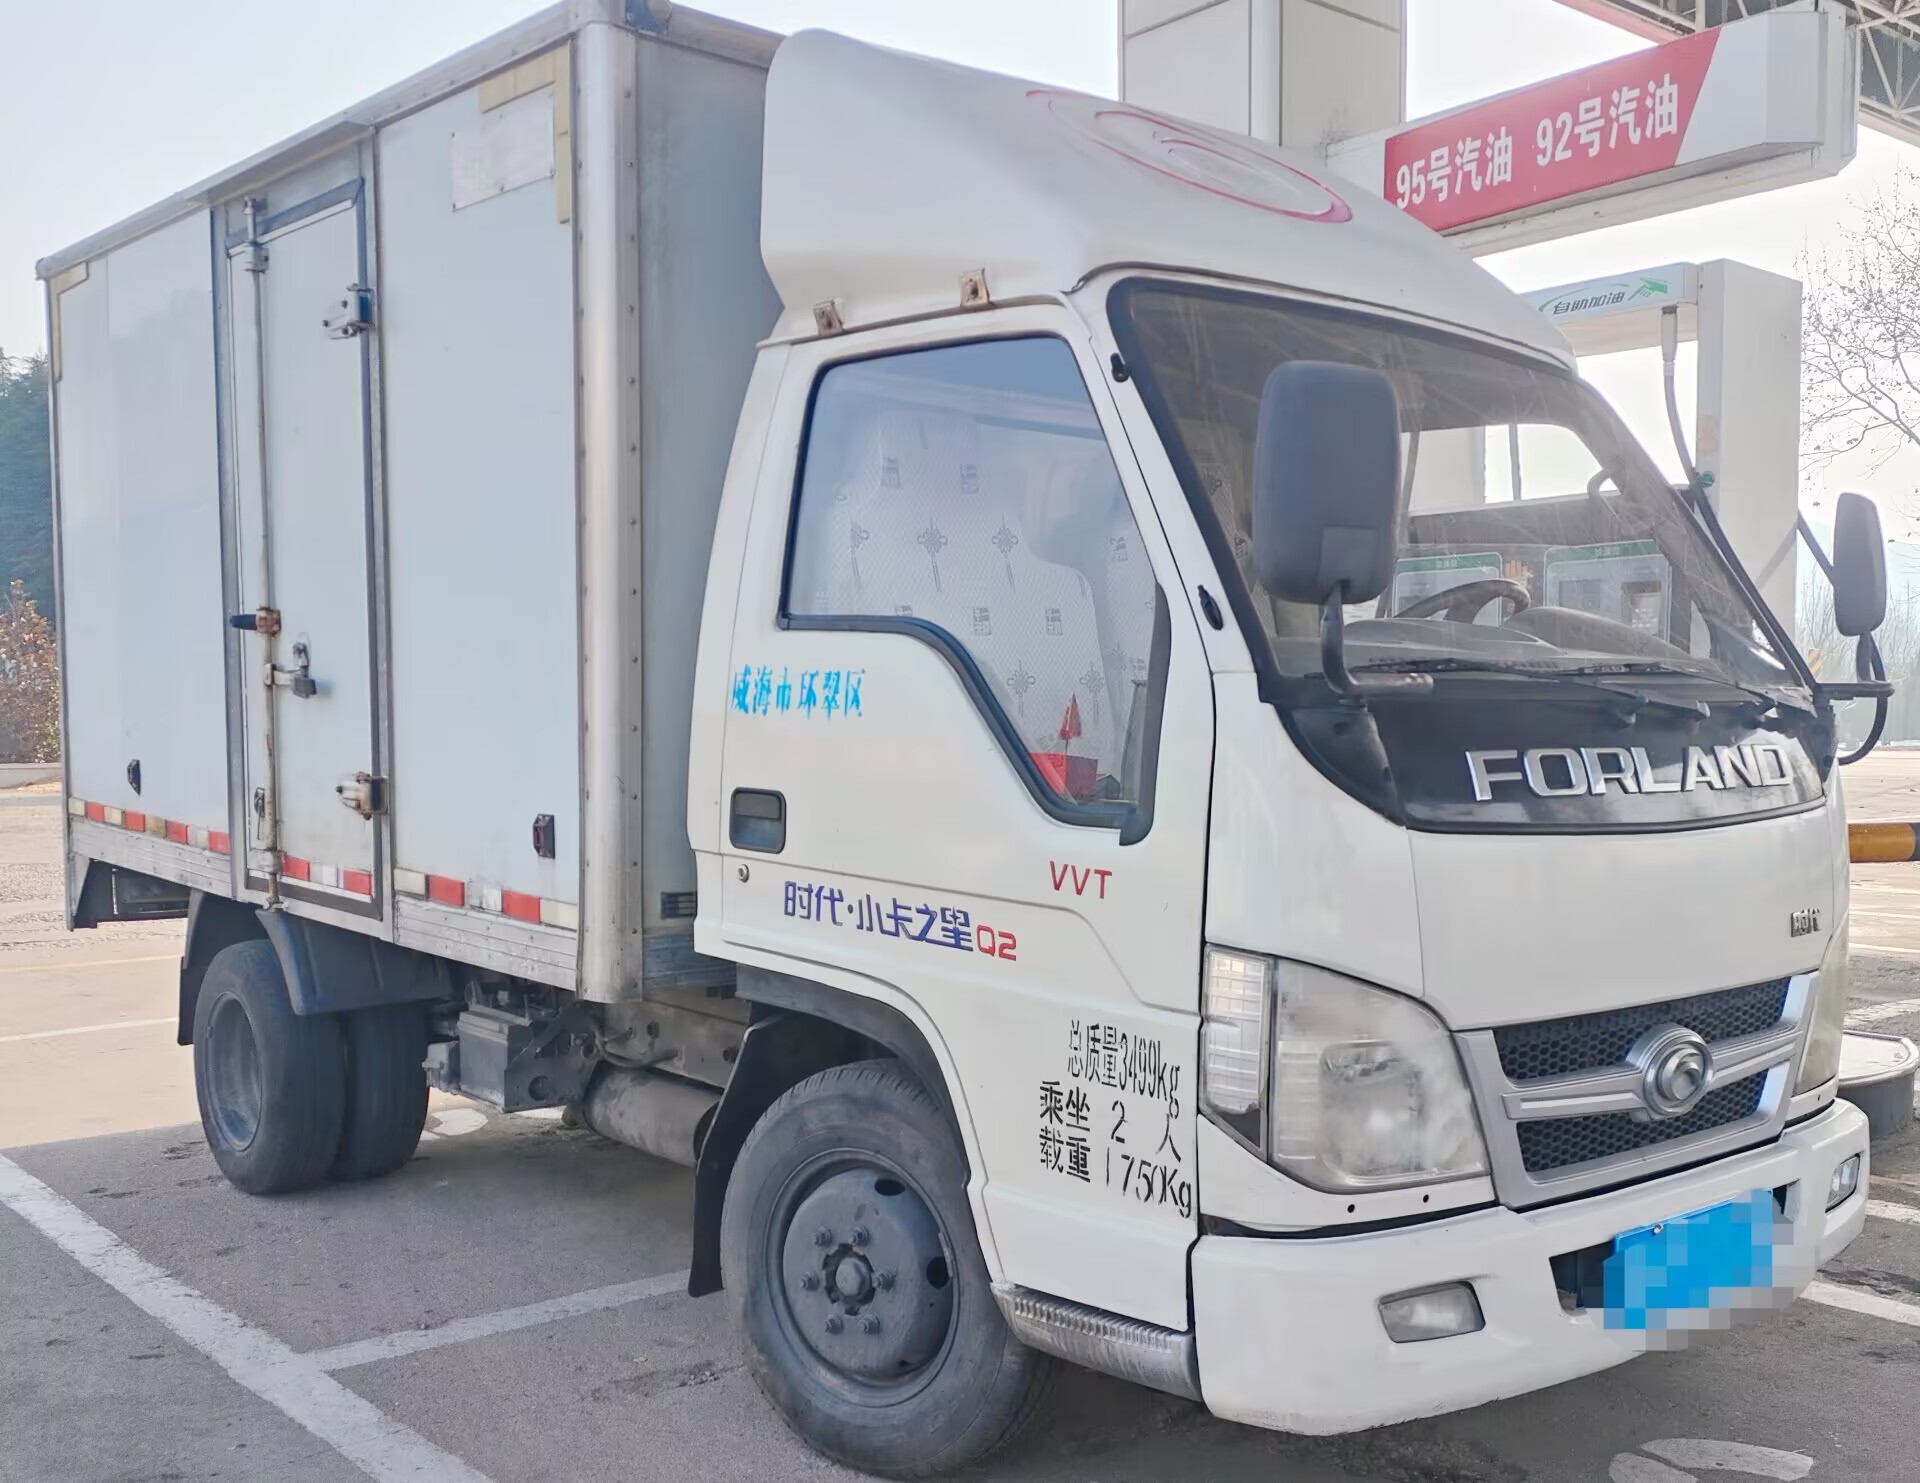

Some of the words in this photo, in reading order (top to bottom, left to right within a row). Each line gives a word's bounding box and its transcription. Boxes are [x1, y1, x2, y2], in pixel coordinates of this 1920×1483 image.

[1396, 126, 1512, 209] 95号汽油
[1536, 73, 1679, 167] 92号汽油
[1553, 291, 1625, 315] 自助加油
[731, 663, 866, 720] 威海市环翠区
[1465, 745, 1794, 802] FORLAND
[1049, 860, 1113, 899] VVT
[1039, 1080, 1091, 1132] 乘坐
[1110, 1099, 1128, 1144] 2
[1154, 1113, 1182, 1163] 人
[1039, 1125, 1091, 1183] 载重
